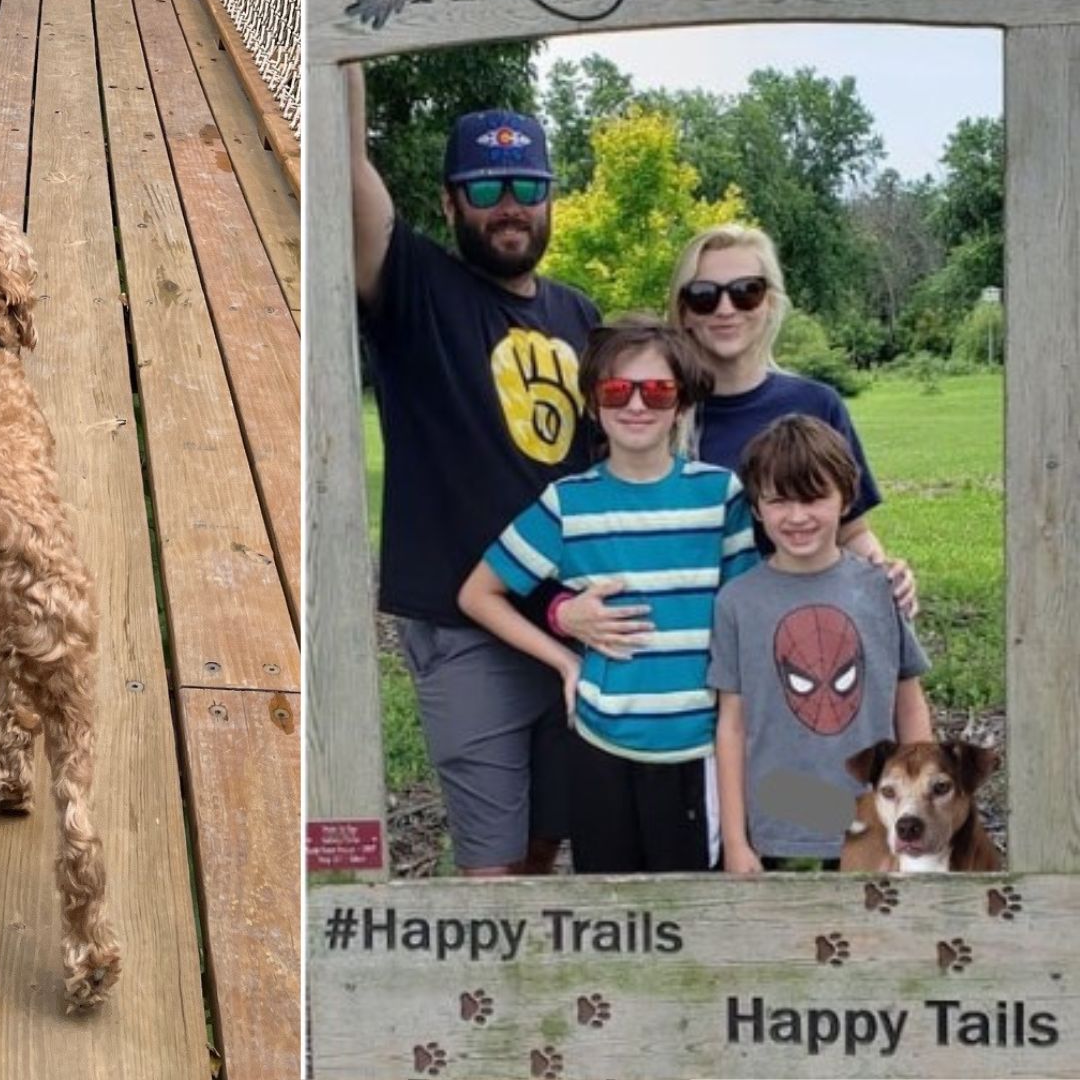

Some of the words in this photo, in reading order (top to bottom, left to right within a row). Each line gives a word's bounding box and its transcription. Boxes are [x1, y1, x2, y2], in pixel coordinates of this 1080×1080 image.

[324, 907, 526, 961] #Happy
[541, 908, 684, 954] Trails
[727, 996, 908, 1057] Happy
[924, 999, 1060, 1048] Tails
